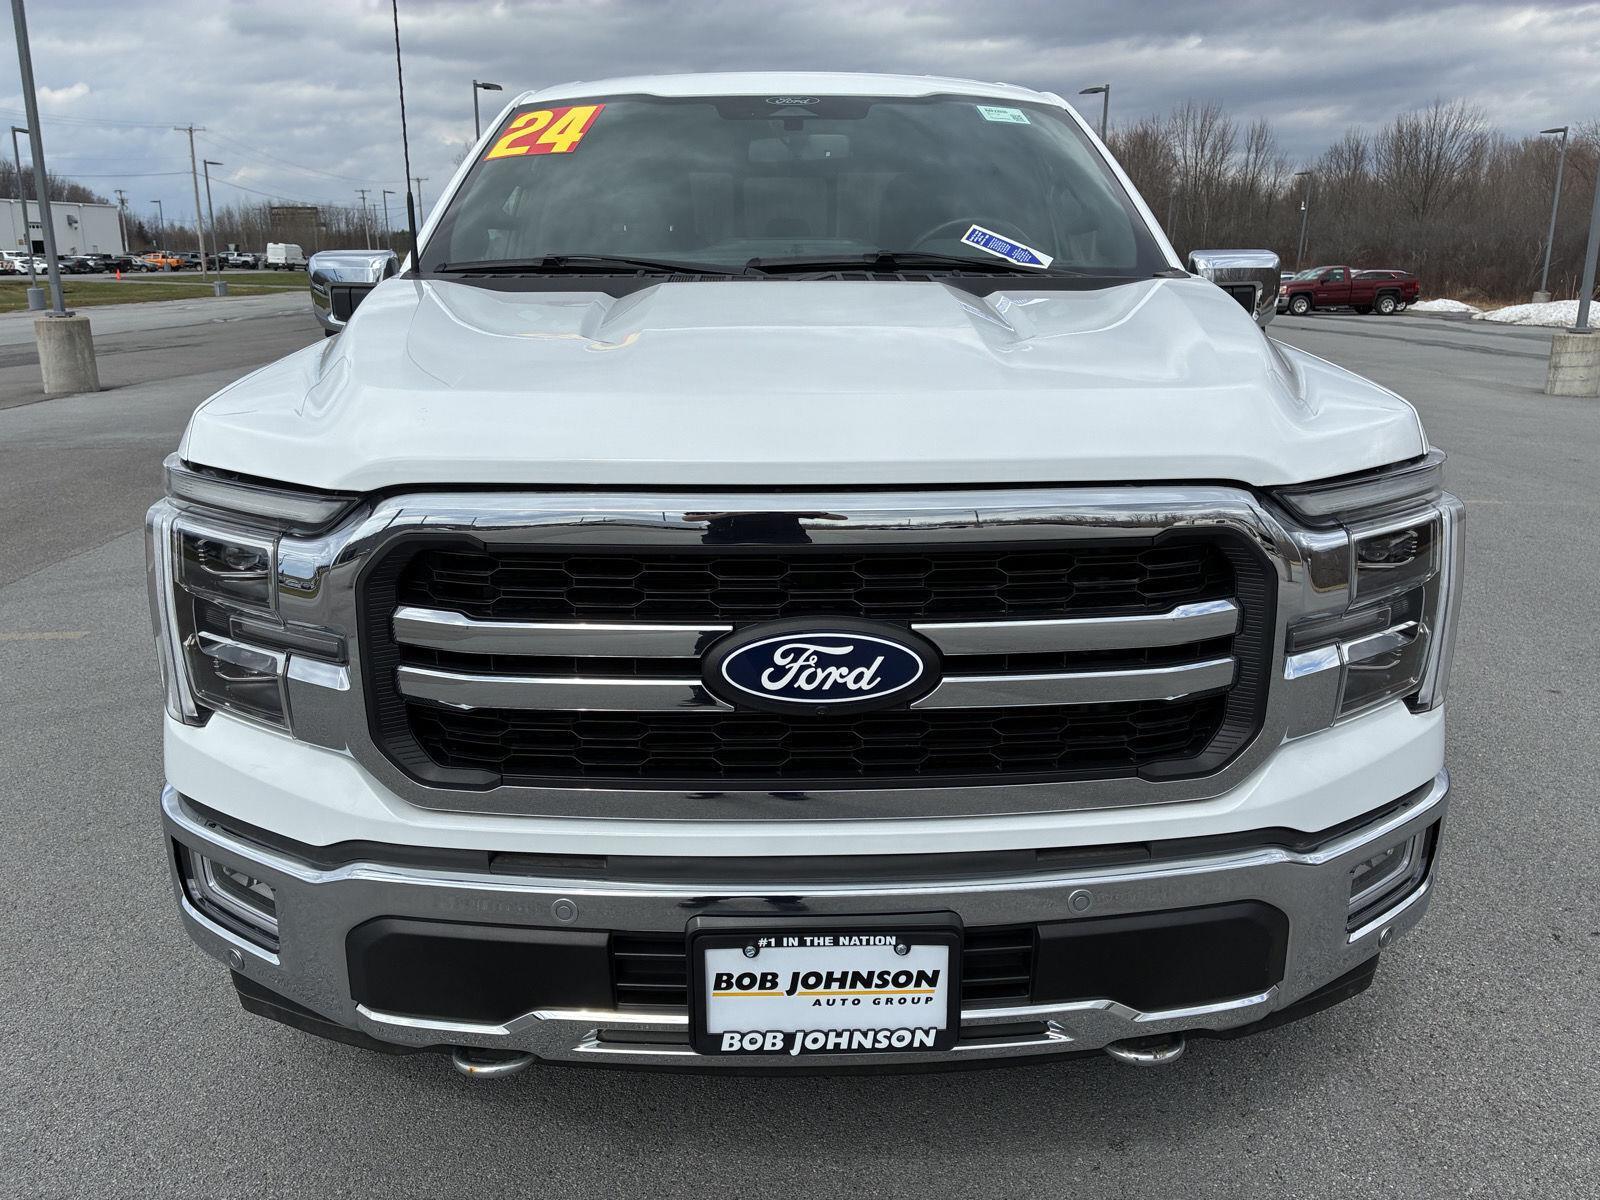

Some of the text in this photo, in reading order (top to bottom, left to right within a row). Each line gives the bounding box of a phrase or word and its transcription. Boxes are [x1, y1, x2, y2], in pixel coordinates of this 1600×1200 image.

[486, 105, 599, 160] 24
[761, 643, 884, 691] Ford
[758, 935, 896, 947] #1 IN THE NATION
[713, 969, 940, 996] BOB JOHNSON
[812, 996, 934, 1007] AUTO GROUP
[721, 1028, 937, 1056] BOB JOHNSON
